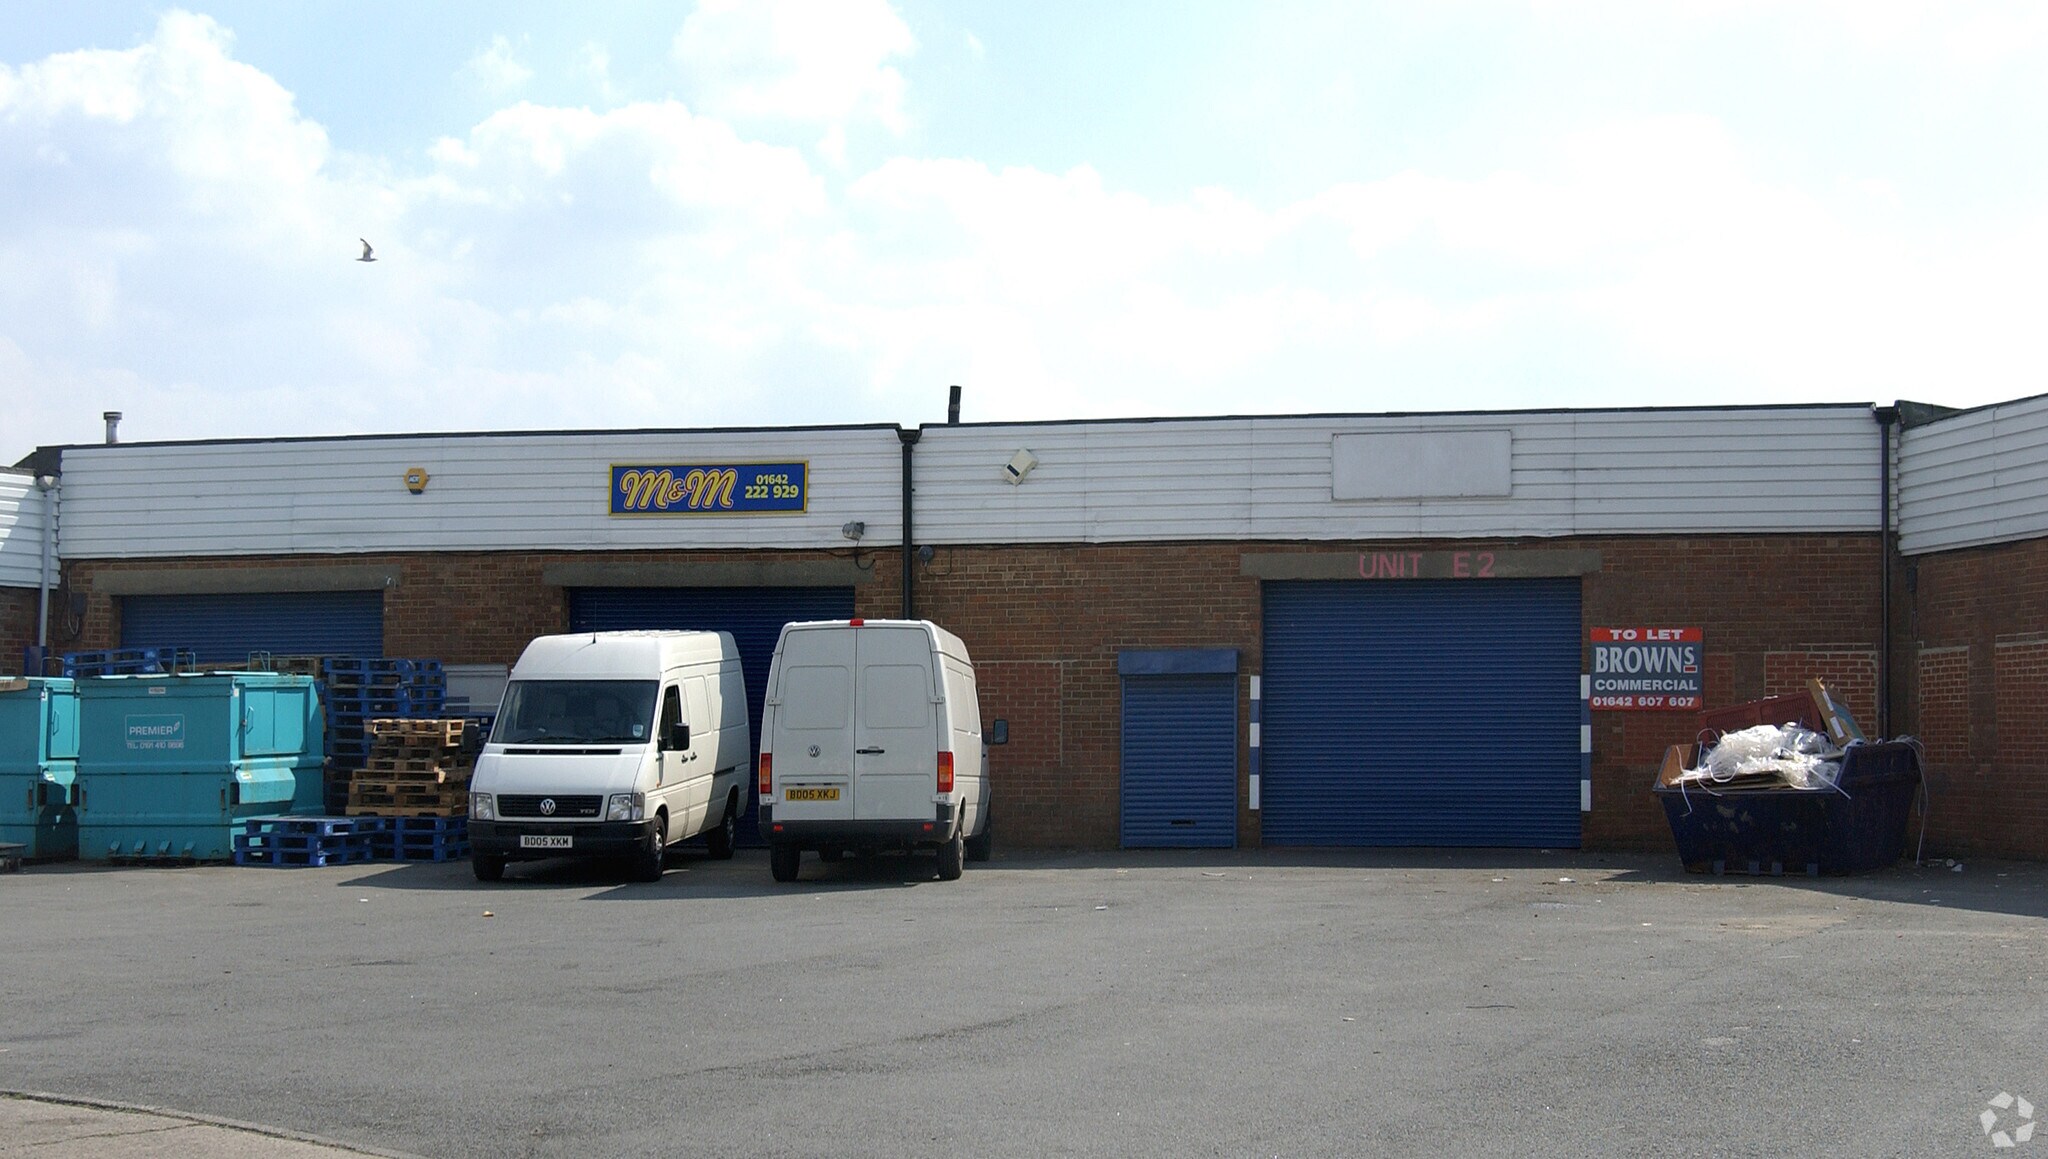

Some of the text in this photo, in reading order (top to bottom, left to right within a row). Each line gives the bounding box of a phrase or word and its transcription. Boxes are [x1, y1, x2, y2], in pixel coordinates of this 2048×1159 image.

[756, 474, 788, 485] 01642
[620, 469, 738, 509] M&M
[745, 485, 799, 499] 222 929
[1359, 551, 1496, 578] UNIT E2
[1610, 629, 1684, 640] TO LET
[1595, 646, 1695, 673] BROWNS
[1595, 679, 1698, 691] COMMERCIAL
[1593, 696, 1694, 706] 01642 607 607
[129, 726, 173, 735] PREMIER
[789, 789, 837, 800] BD05 XKJ
[524, 836, 569, 846] BD05 XKM
